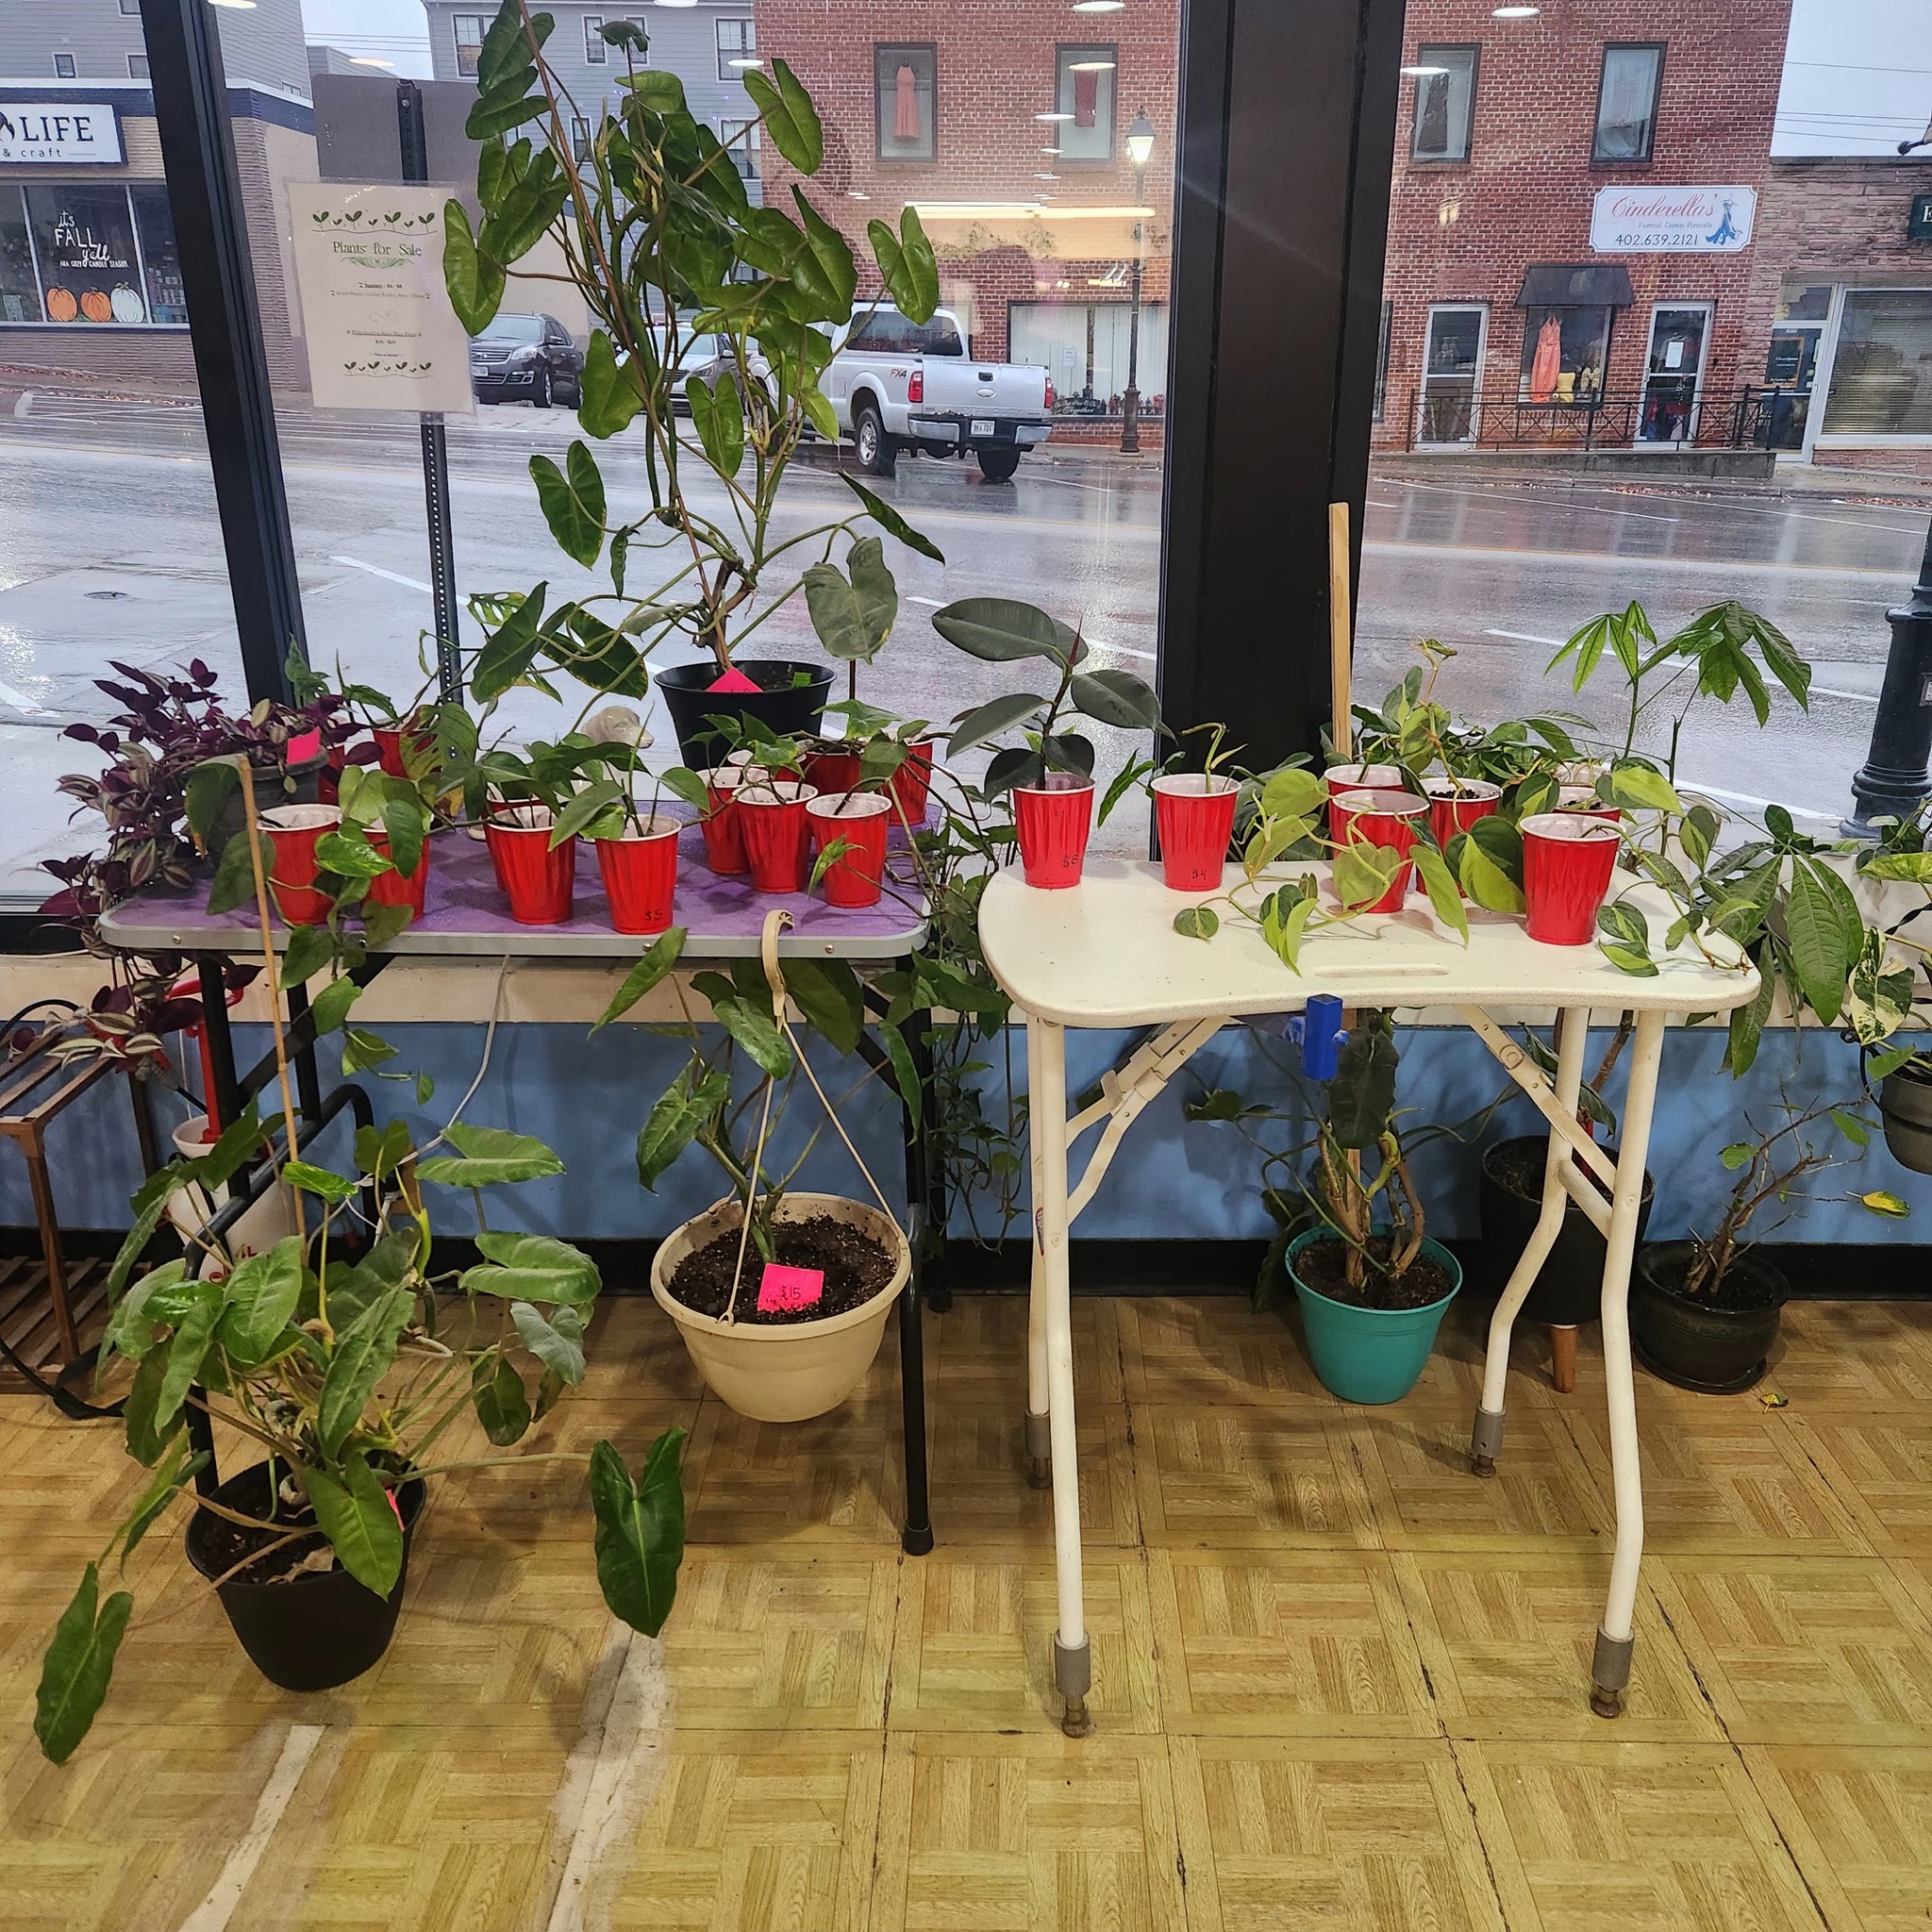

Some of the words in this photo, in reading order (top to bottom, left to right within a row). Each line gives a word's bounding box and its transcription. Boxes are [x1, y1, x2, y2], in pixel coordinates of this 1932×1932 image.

[19, 116, 94, 142] LIFE
[21, 148, 61, 158] craft
[55, 227, 98, 247] FALL
[1615, 234, 1698, 245] 402.639.2121
[333, 241, 367, 255] Plants
[373, 242, 391, 256] for
[398, 242, 423, 258] Sale
[890, 368, 908, 378] FX4
